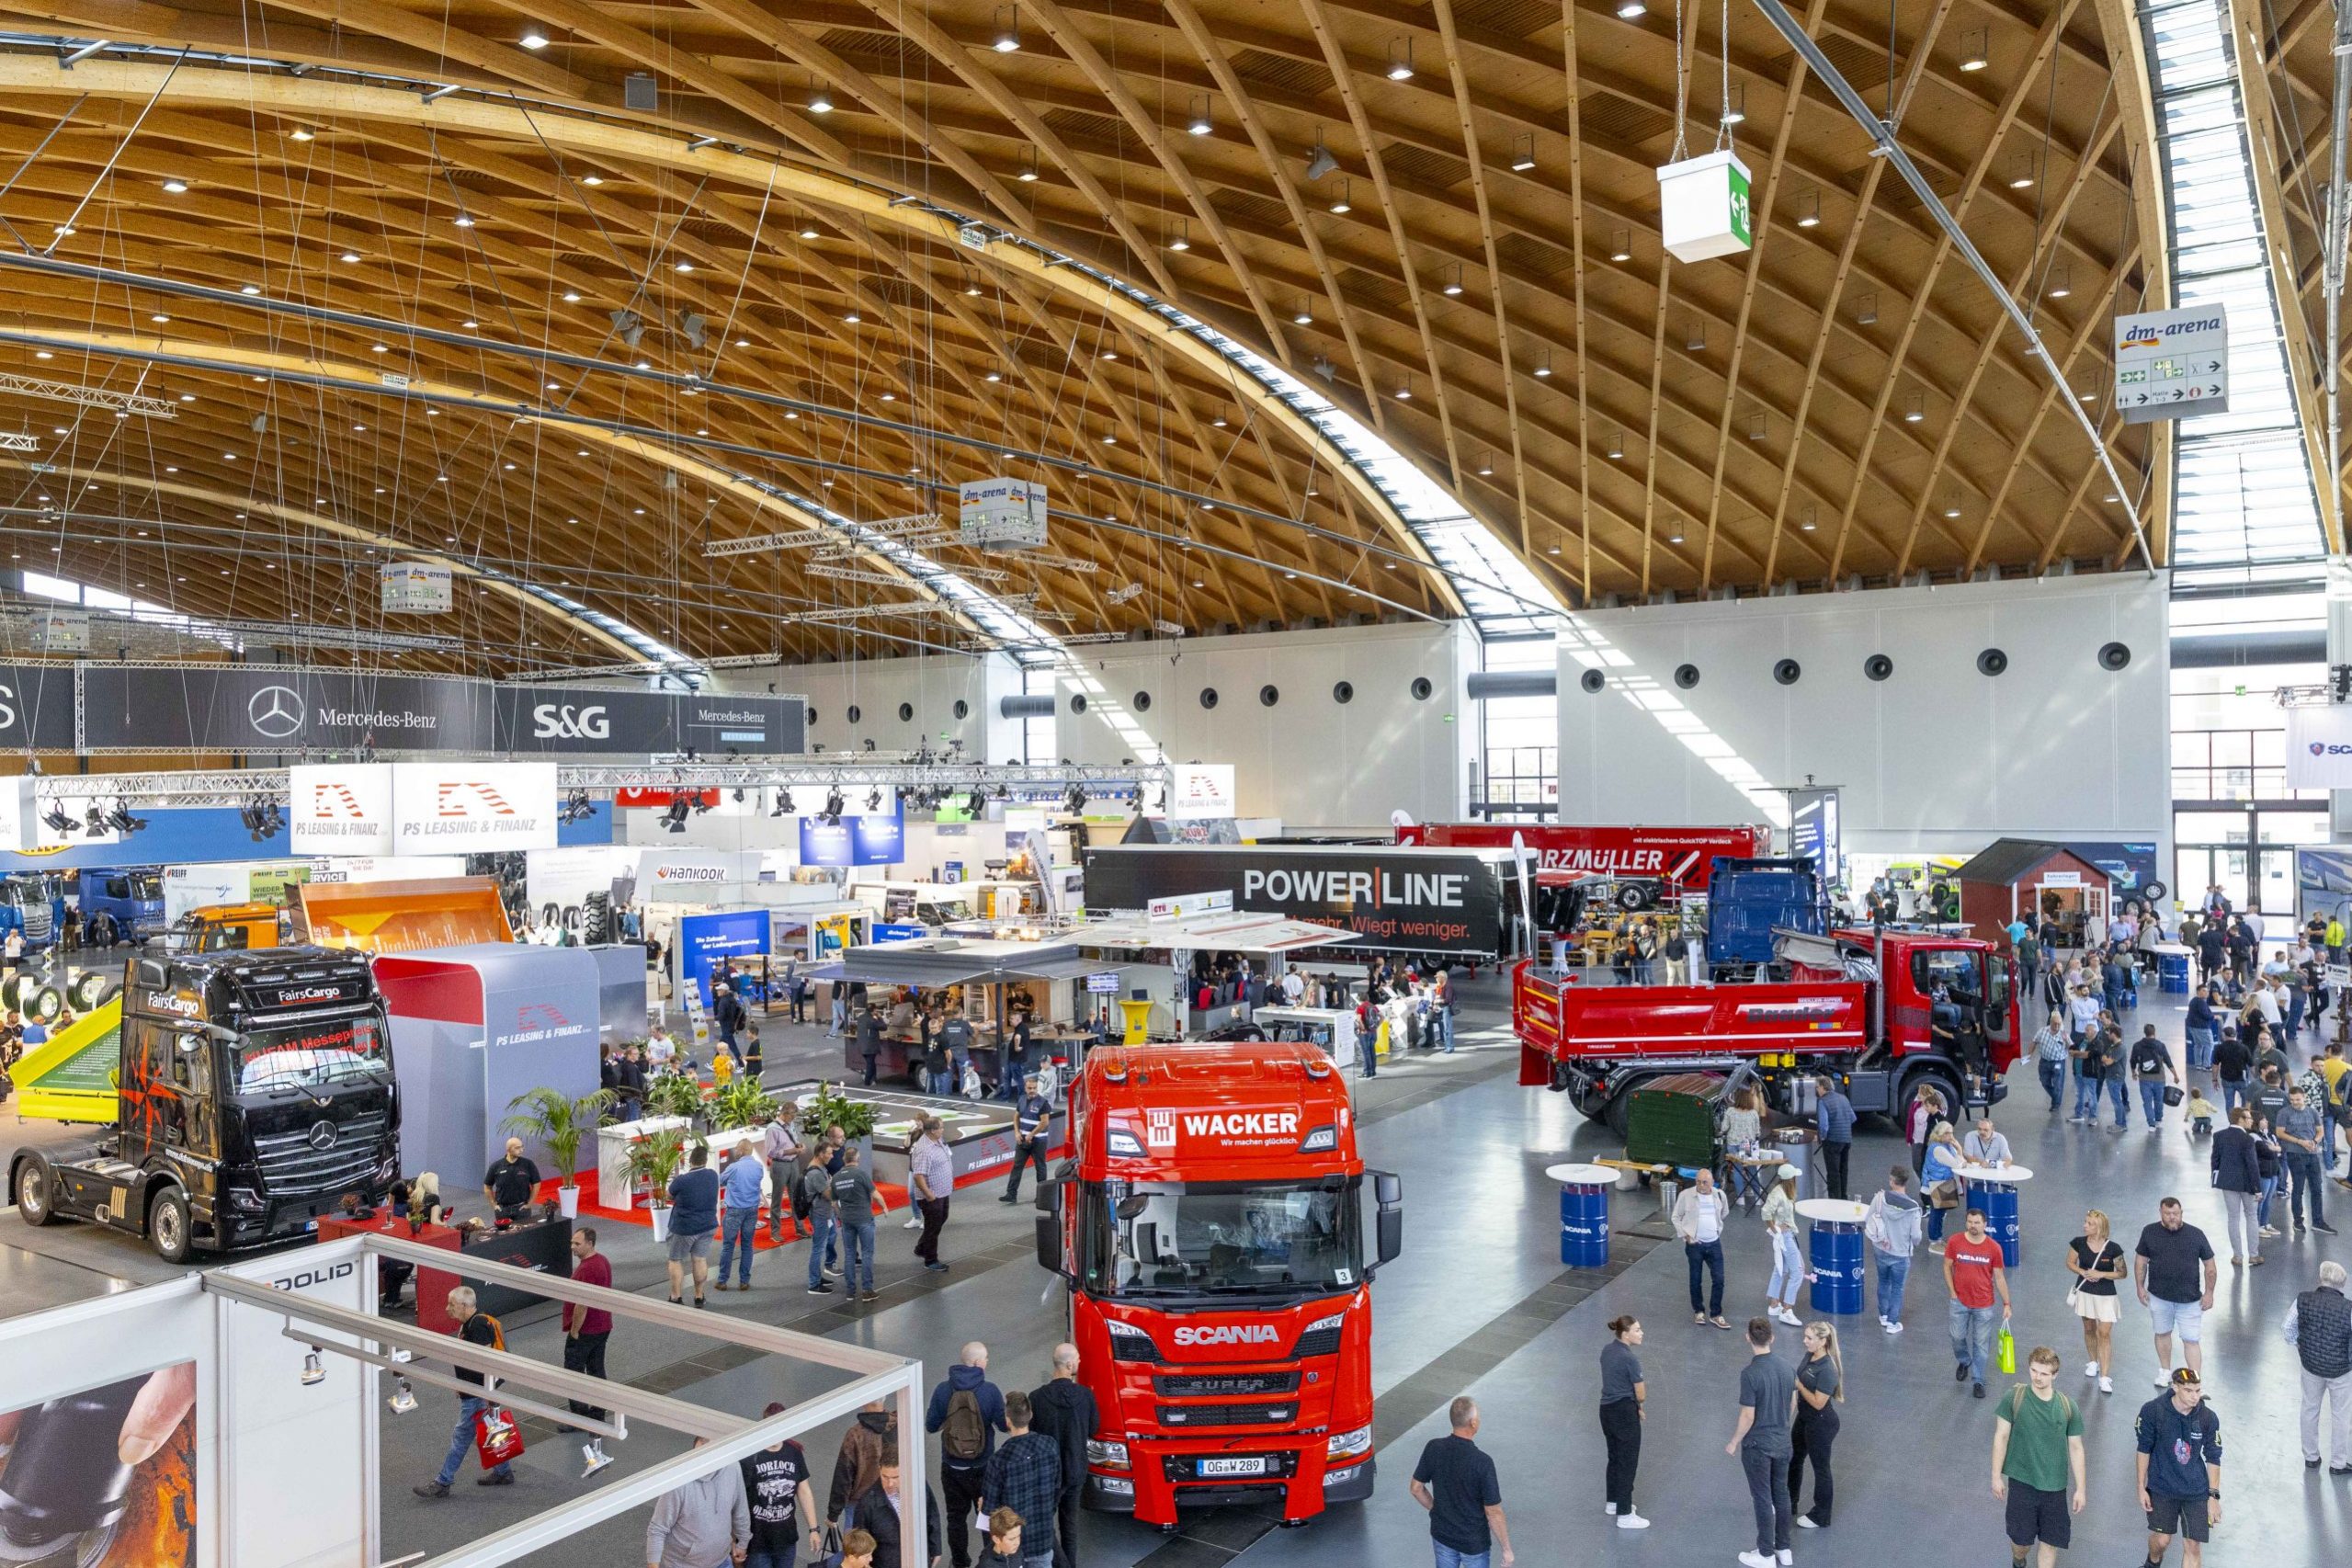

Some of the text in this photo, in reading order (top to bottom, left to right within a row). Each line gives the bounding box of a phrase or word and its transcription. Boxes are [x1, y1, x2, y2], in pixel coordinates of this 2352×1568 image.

[2126, 318, 2220, 341] dm-arena
[964, 488, 1006, 500] dm-arena
[412, 568, 450, 580] dm-arena
[51, 616, 88, 625] dm-arena
[319, 709, 437, 729] Mercedes-Benz
[533, 704, 610, 740] S&G
[699, 710, 766, 723] Mercedes-Benz
[2328, 744, 2352, 755] SC
[296, 823, 378, 836] PS LEASING & FINANZ
[403, 819, 537, 836] PS LEASING & FINANZ
[171, 869, 187, 878] REIFF
[669, 868, 725, 881] HANKOOK
[1350, 915, 1397, 938] Wiegt
[1401, 920, 1471, 942] weniger.
[706, 935, 727, 943] Zukunft
[278, 986, 340, 1003] FairsCargo
[148, 991, 199, 1017] FairsCargo
[496, 1035, 508, 1047] PS
[509, 1029, 544, 1044] LEASING
[546, 1029, 552, 1040] &
[554, 1024, 583, 1038] FINANZ
[1184, 1112, 1298, 1137] WACKER
[1264, 1138, 1299, 1148] glücklich.
[968, 1161, 976, 1171] PS
[1564, 1225, 1592, 1234] SCANIA
[265, 1262, 354, 1291] DOLID
[1339, 1271, 1348, 1283] 3
[1812, 1266, 1843, 1278] SCANIA
[1174, 1324, 1280, 1346] SCANIA
[1190, 1379, 1266, 1392] SUPER
[1208, 1460, 1260, 1472] OG W 289
